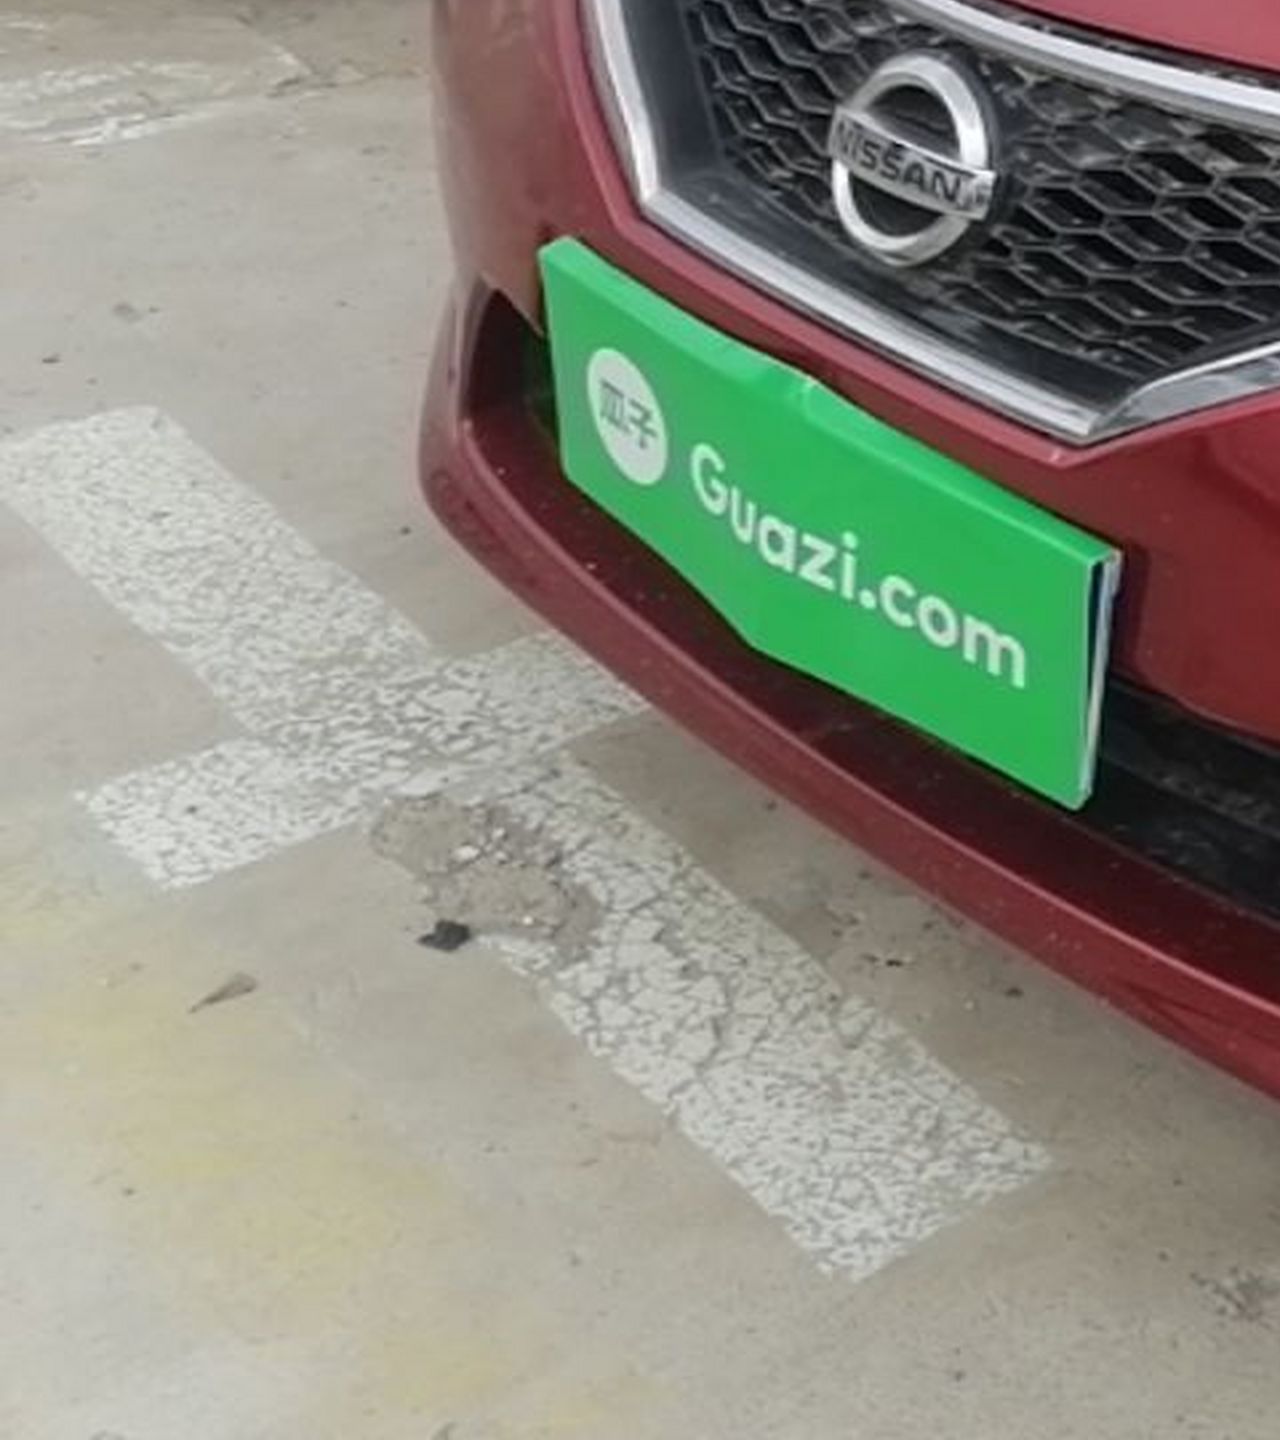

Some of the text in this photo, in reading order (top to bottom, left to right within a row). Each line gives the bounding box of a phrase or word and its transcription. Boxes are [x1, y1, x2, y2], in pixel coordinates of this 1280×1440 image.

[835, 117, 963, 202] NISSAN
[599, 378, 659, 450] 瓜子
[689, 441, 1027, 690] Guazi.com
